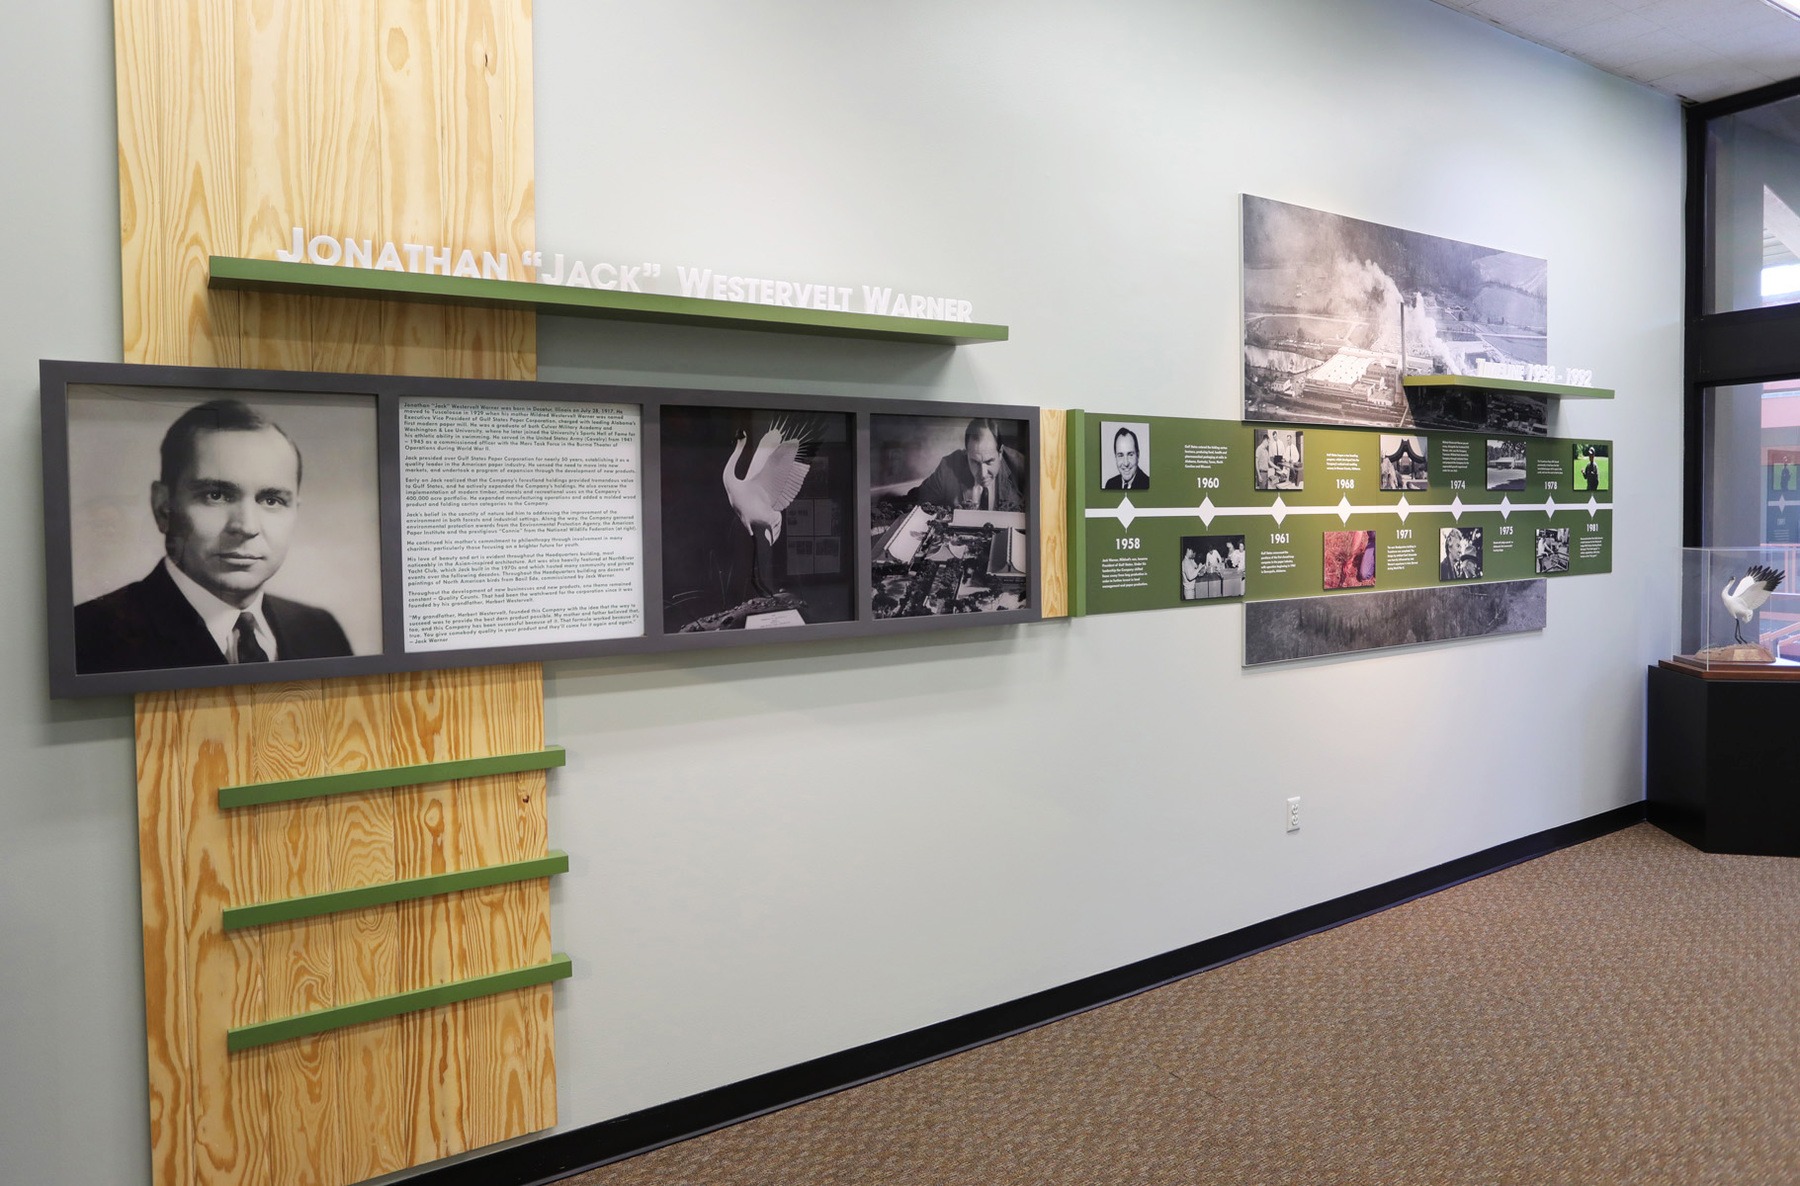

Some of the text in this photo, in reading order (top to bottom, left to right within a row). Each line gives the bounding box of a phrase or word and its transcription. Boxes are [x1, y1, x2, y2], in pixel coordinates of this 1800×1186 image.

[277, 227, 973, 323] JONATHAN “JACK” WESTERVELT WARNER
[1526, 363, 1555, 383] 1958
[1198, 478, 1219, 488] 1960
[1336, 479, 1354, 489] 1968
[1451, 480, 1465, 489] 1974
[1397, 530, 1411, 539] 1971
[1500, 526, 1513, 535] 1975
[1271, 533, 1289, 543] 1961
[1116, 538, 1140, 549] 1958
